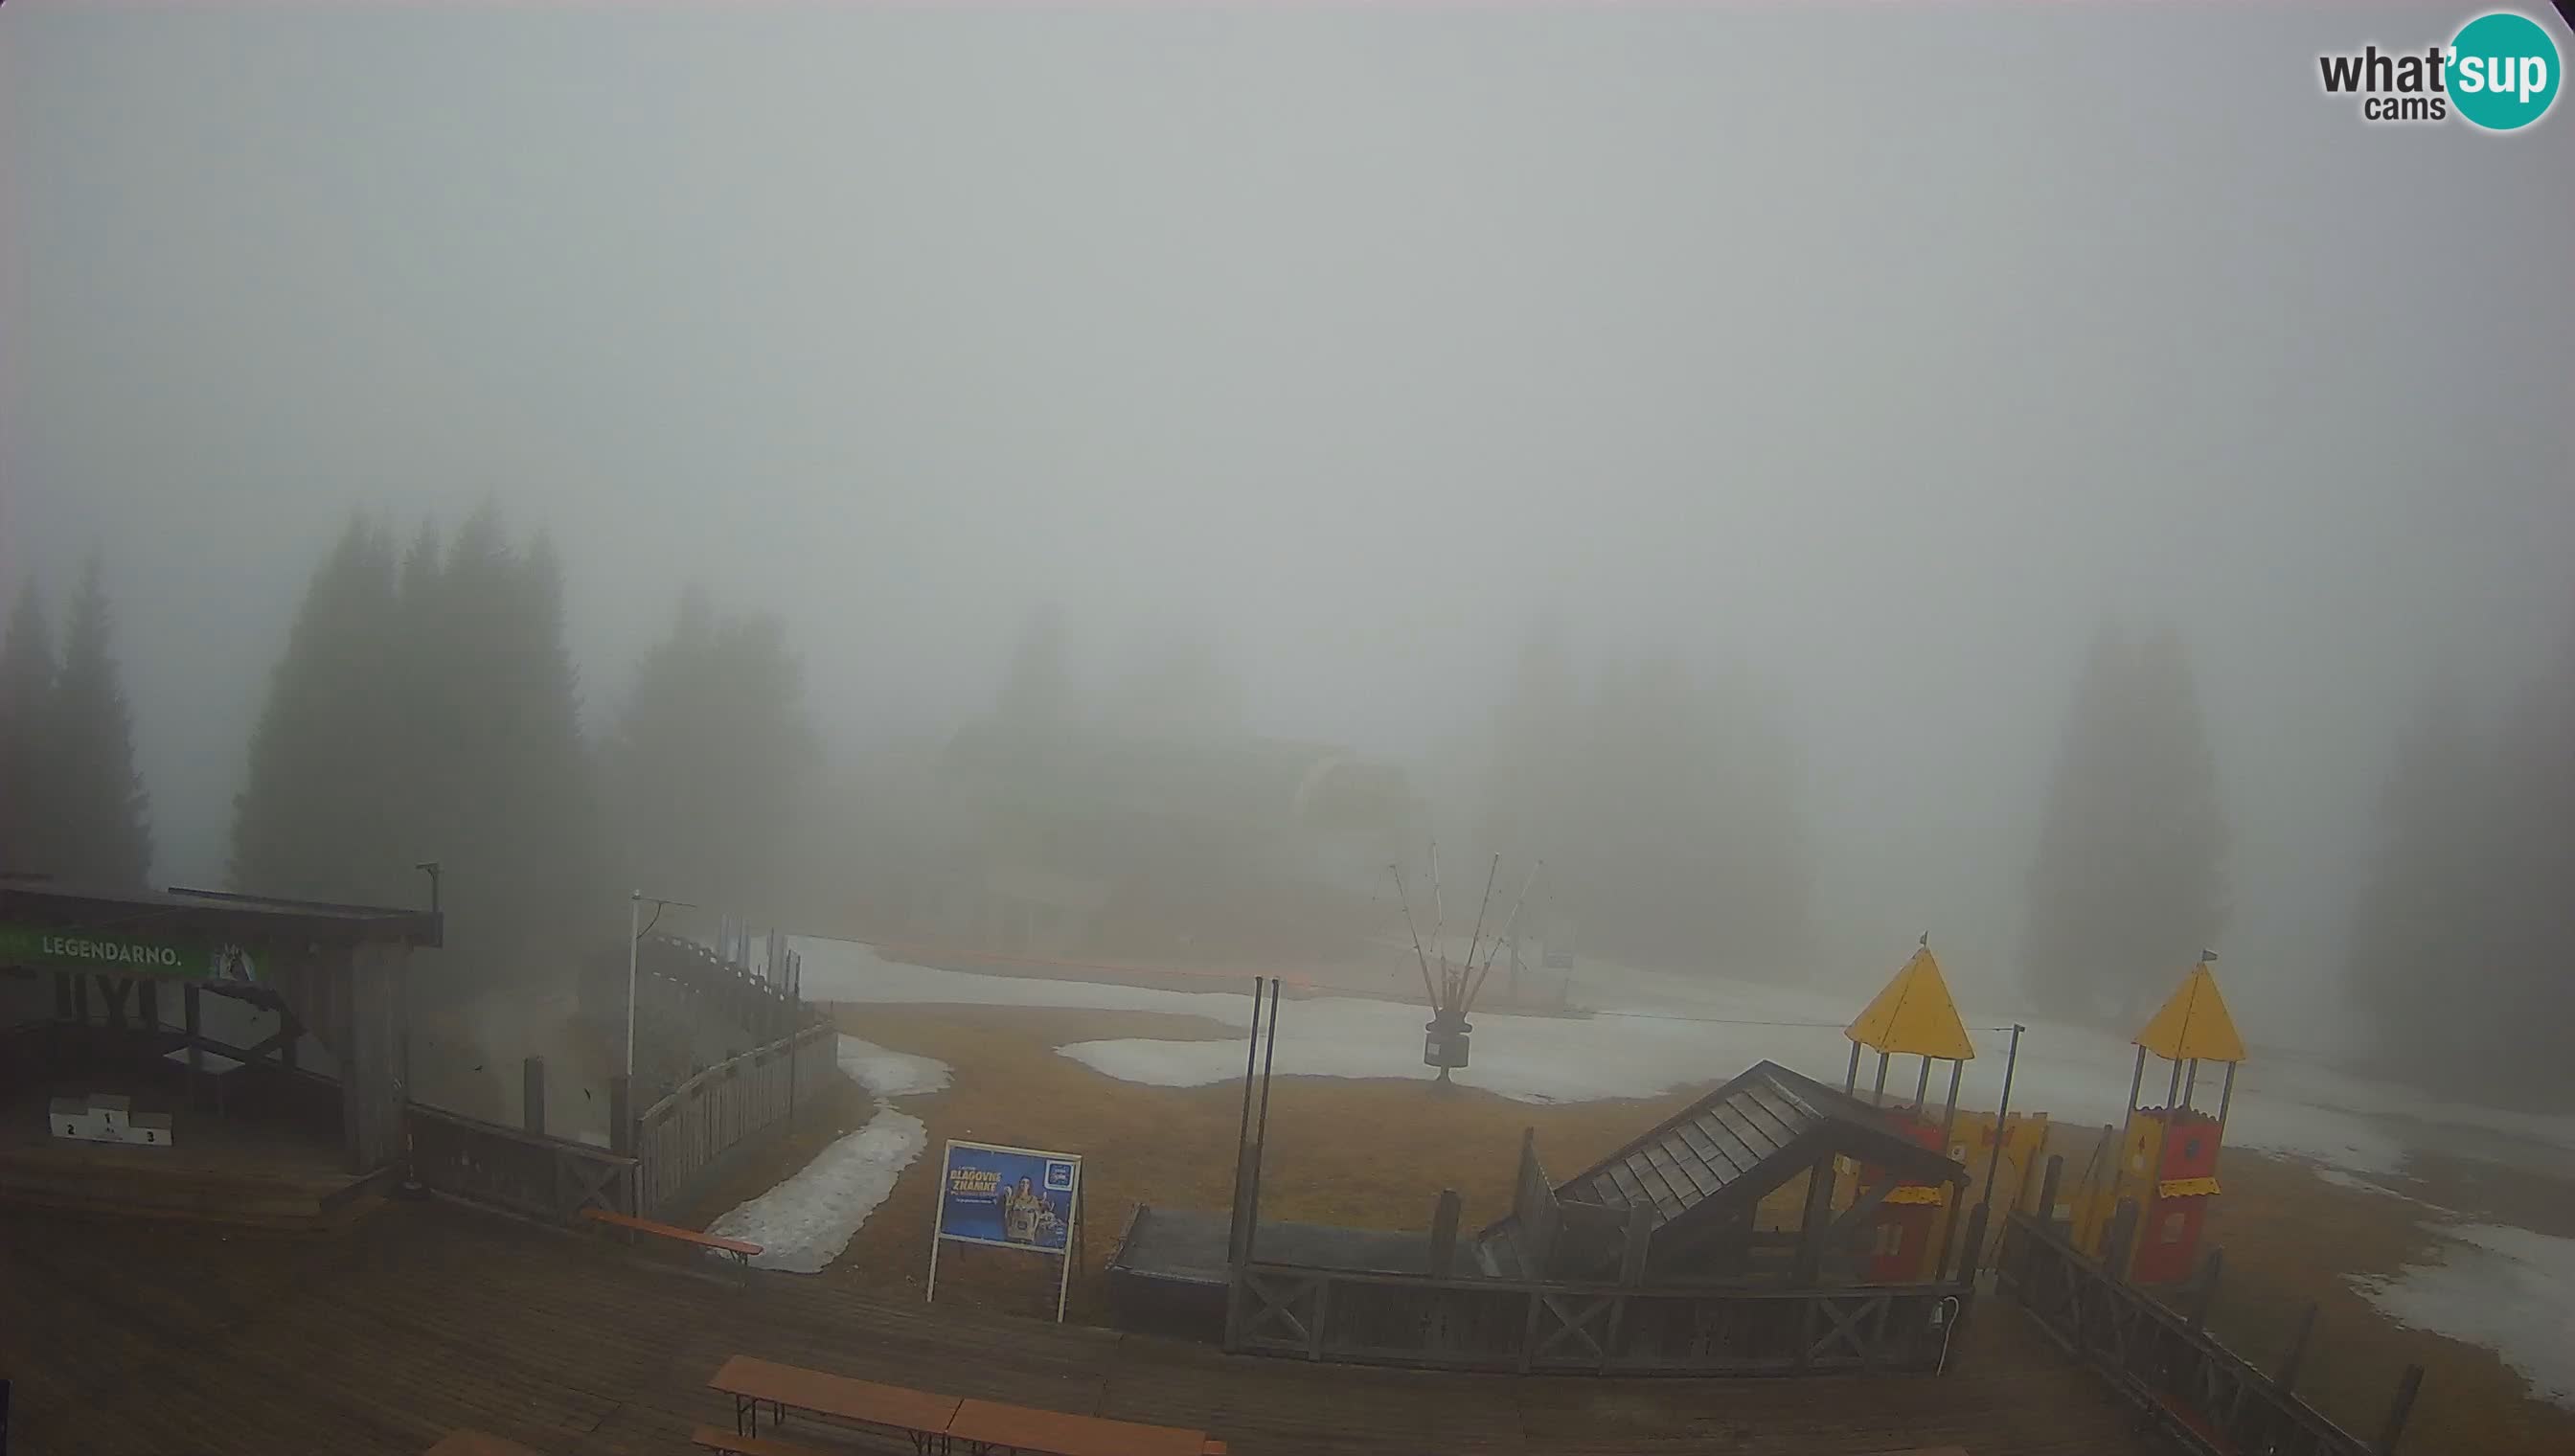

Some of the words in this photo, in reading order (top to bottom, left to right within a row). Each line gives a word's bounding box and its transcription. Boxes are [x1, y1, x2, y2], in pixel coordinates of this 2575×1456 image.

[43, 935, 182, 967] LEGENDARNO.
[67, 1124, 75, 1135] 2
[147, 1131, 154, 1143] 3
[950, 1170, 1003, 1182] BLAGOVNE
[952, 1180, 997, 1192] ZNAMKE
